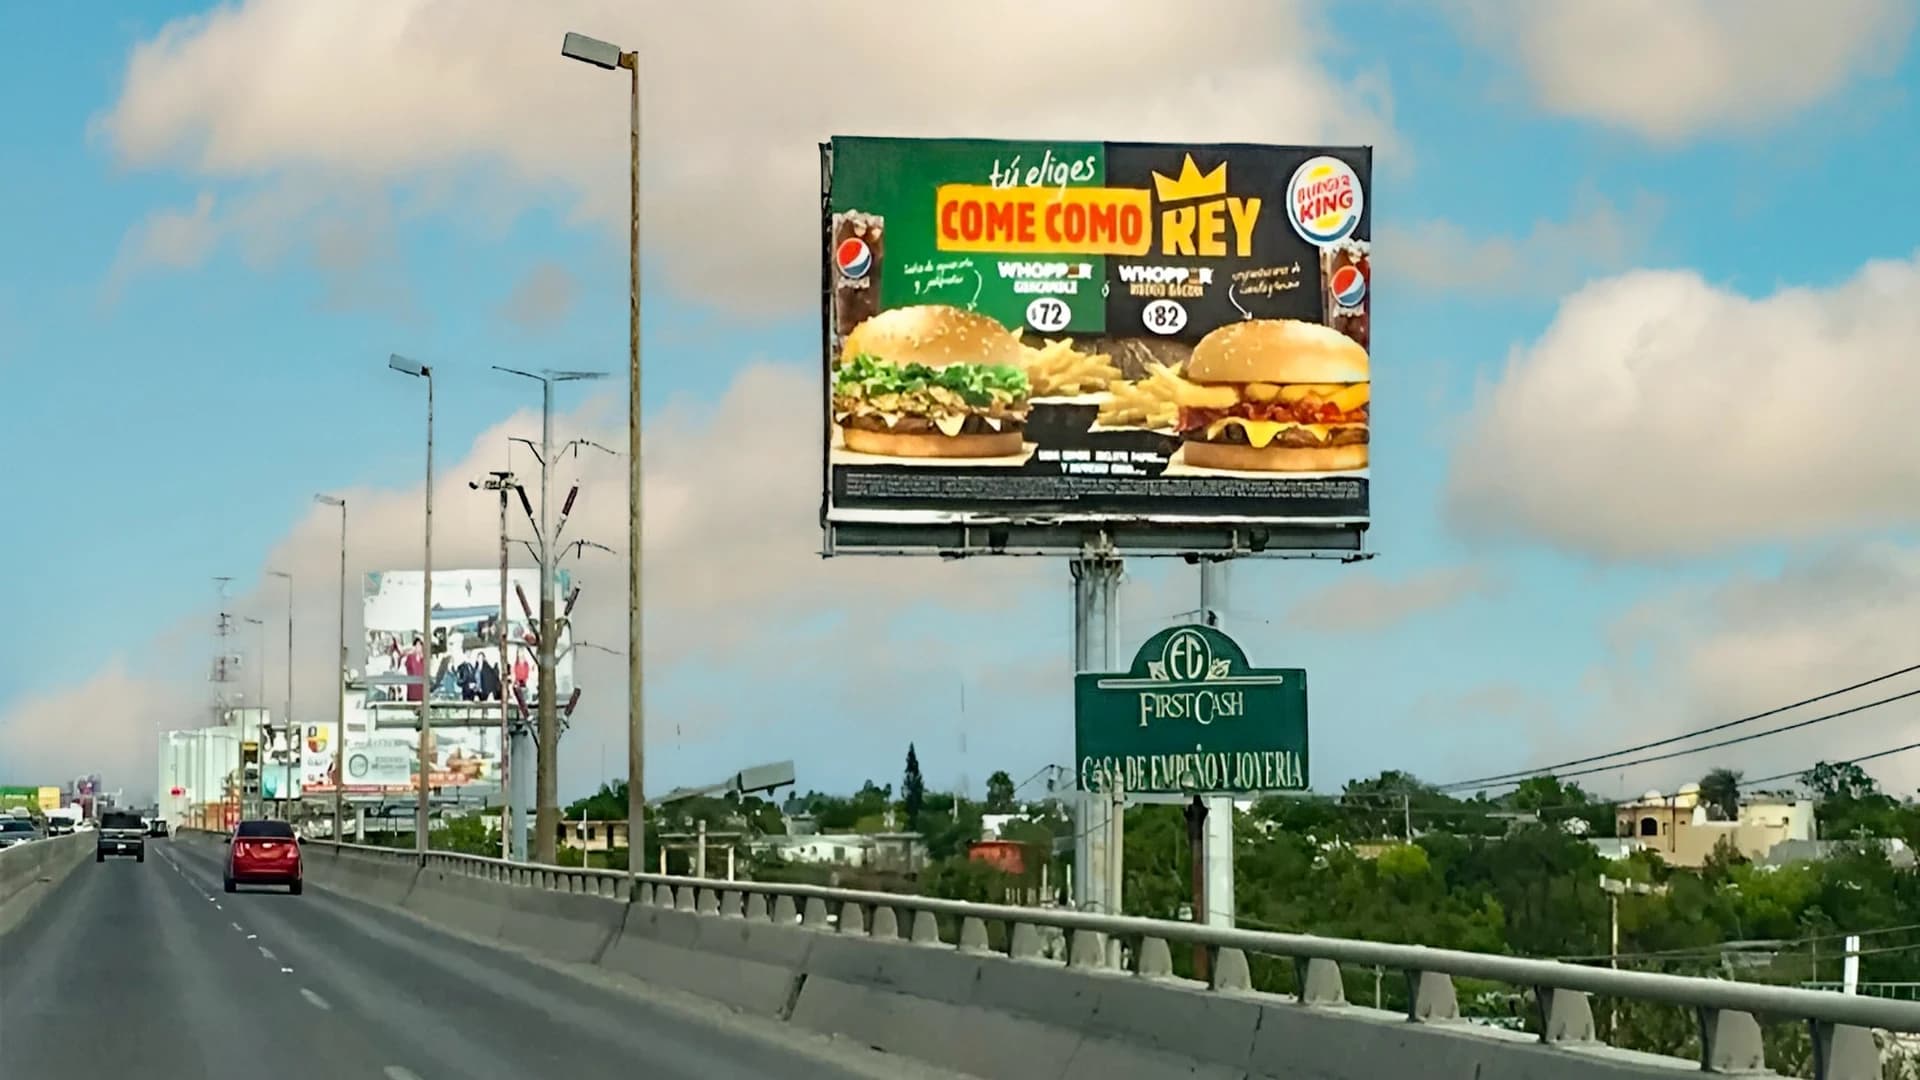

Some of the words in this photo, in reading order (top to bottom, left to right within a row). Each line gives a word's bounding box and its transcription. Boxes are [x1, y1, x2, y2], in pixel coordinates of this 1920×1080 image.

[1025, 149, 1096, 201] eliges
[941, 200, 1036, 243] COME
[1045, 202, 1143, 246] COMO
[1162, 197, 1262, 257] REY
[1300, 189, 1354, 224] KING
[1125, 755, 1147, 792] DE
